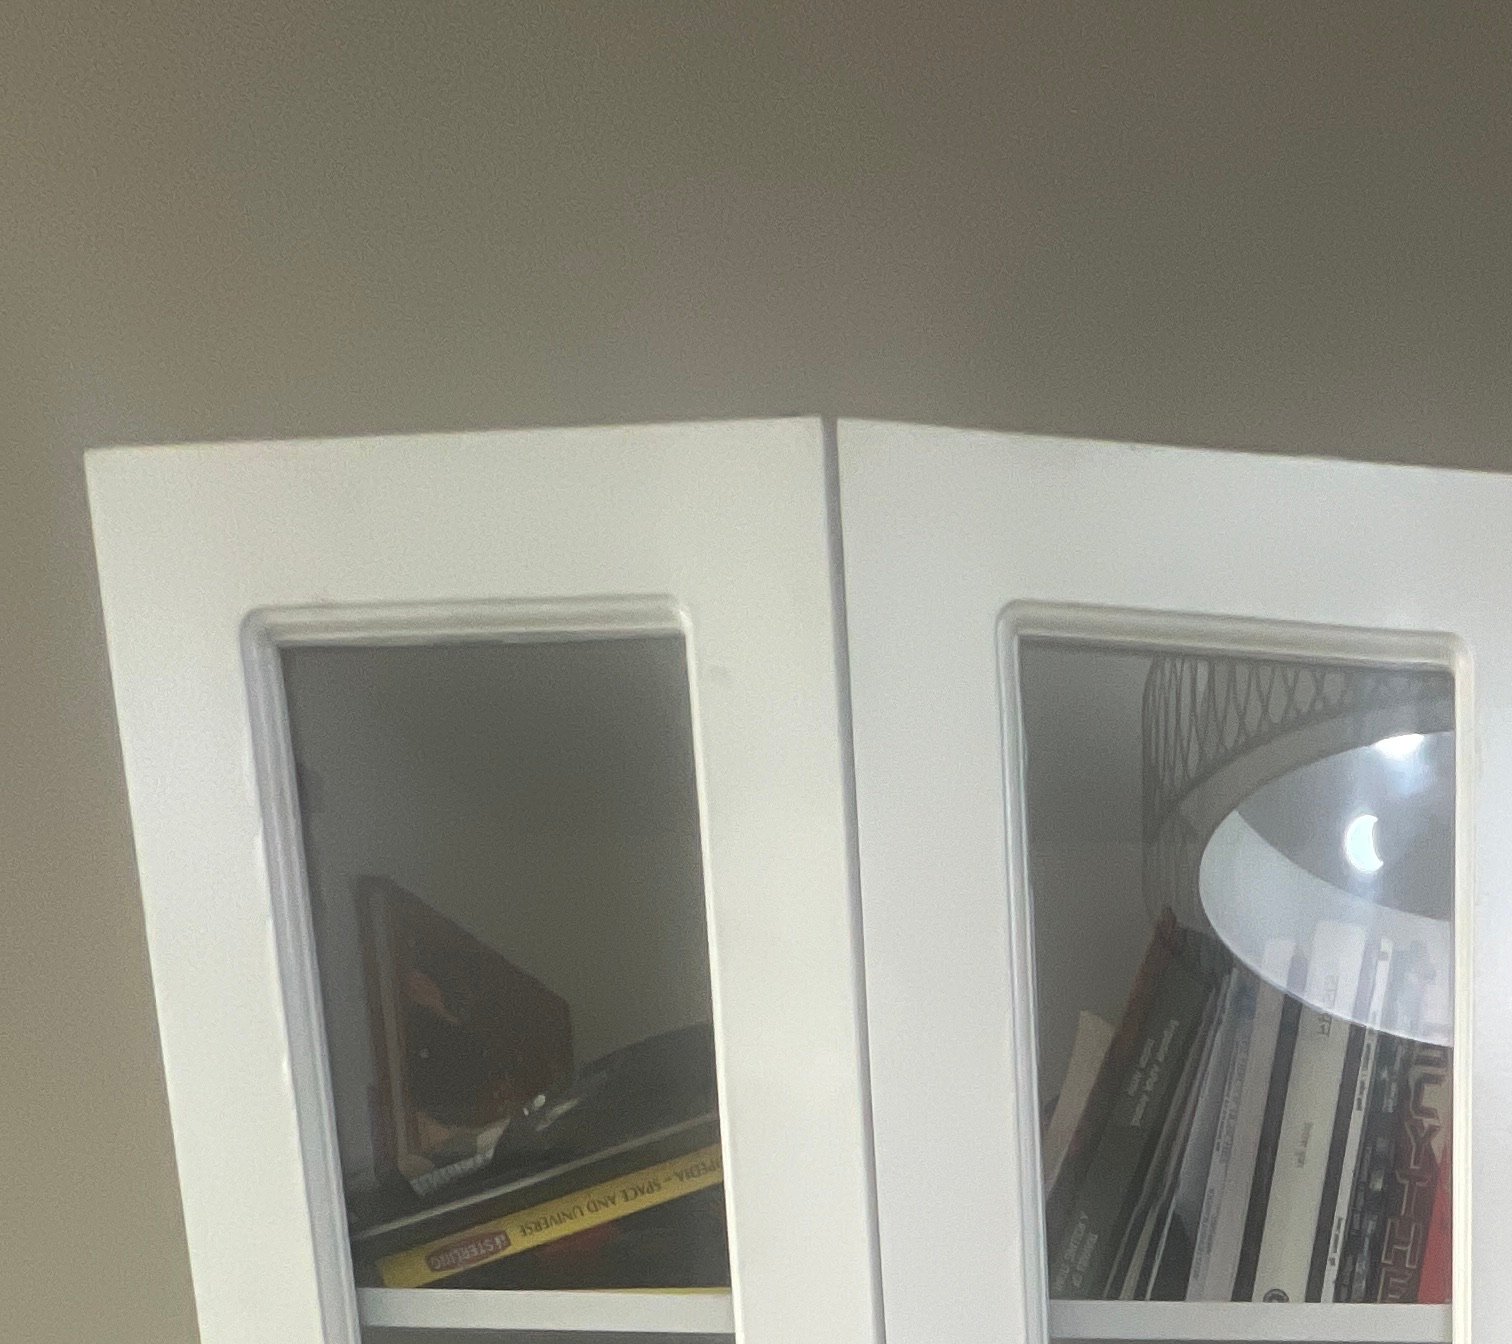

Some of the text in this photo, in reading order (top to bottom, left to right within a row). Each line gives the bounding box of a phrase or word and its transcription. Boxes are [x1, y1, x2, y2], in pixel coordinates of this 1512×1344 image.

[622, 1180, 662, 1203] SPACE
[586, 1193, 618, 1214] AND
[519, 1205, 584, 1237] UNIVERSE
